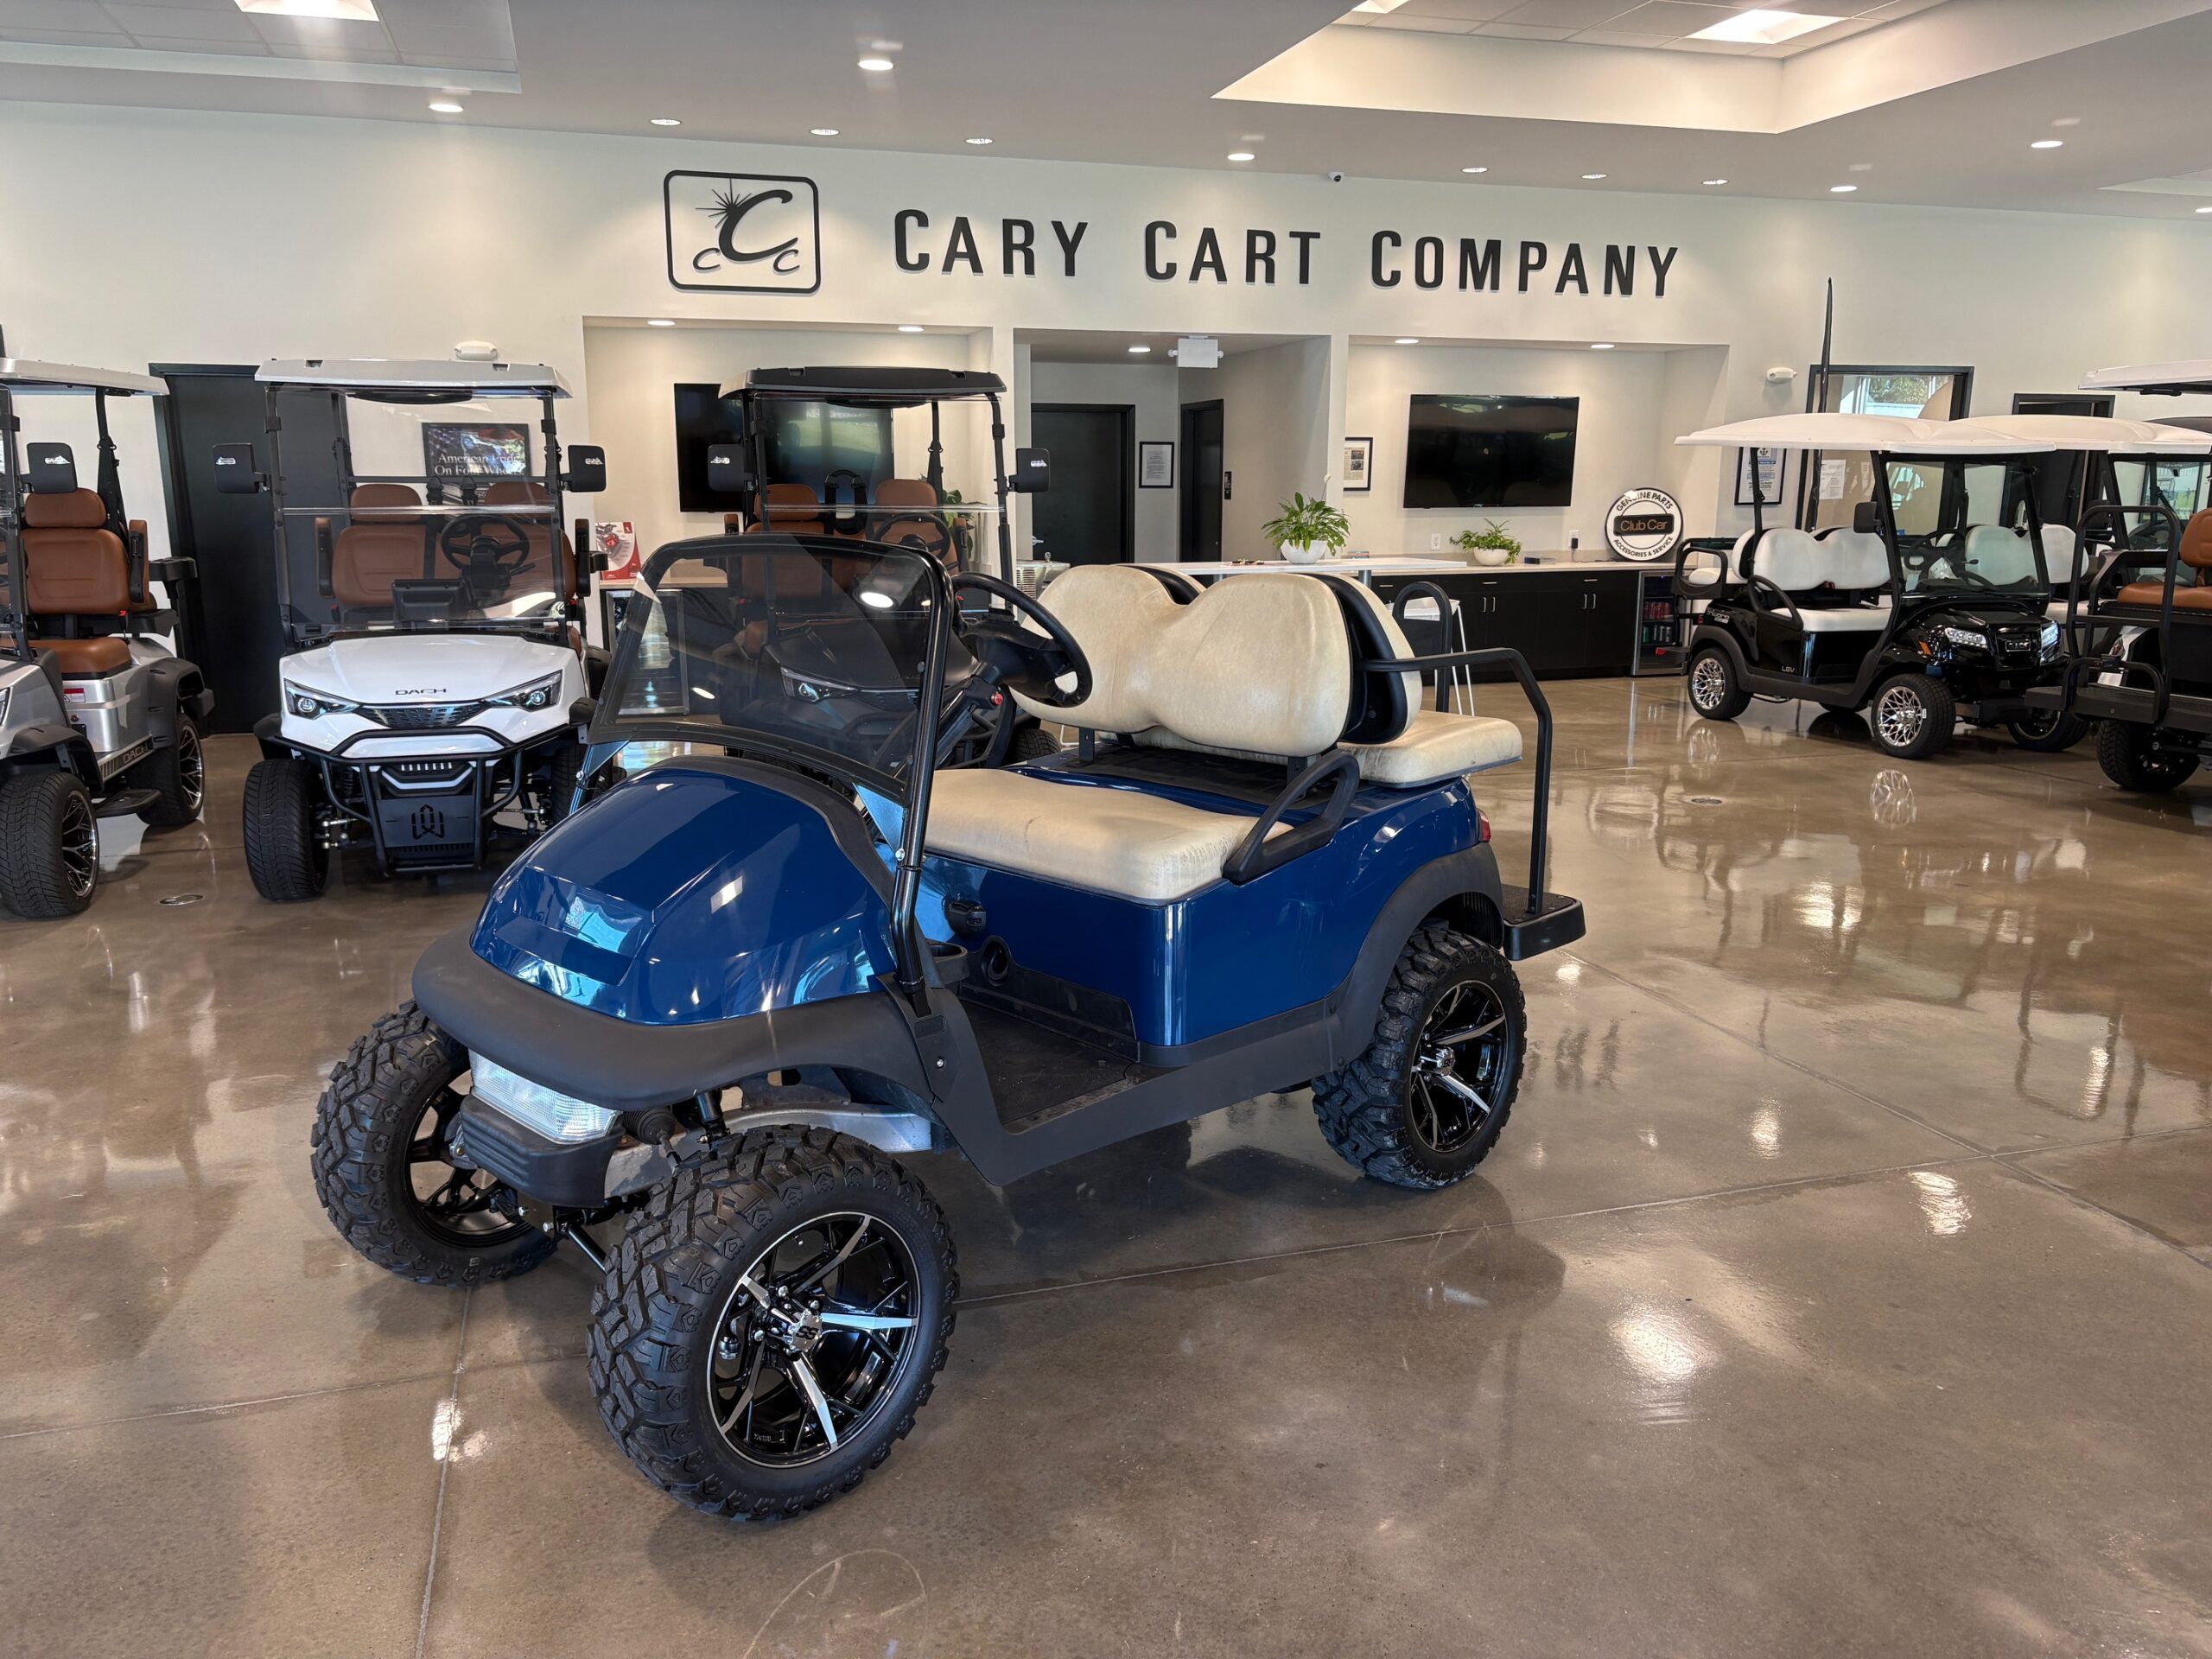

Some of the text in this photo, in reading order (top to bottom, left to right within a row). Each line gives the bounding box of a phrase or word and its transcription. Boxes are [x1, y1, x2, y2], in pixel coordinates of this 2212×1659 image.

[894, 209, 1678, 298] CARY CART COMPANY
[438, 453, 488, 464] American
[434, 465, 452, 475] On
[1652, 492, 1673, 509] PARTS
[1620, 518, 1668, 531] Club Car
[1613, 538, 1647, 557] ACCESSORIES
[1652, 536, 1674, 555] SERVICE
[123, 743, 149, 764] DACH
